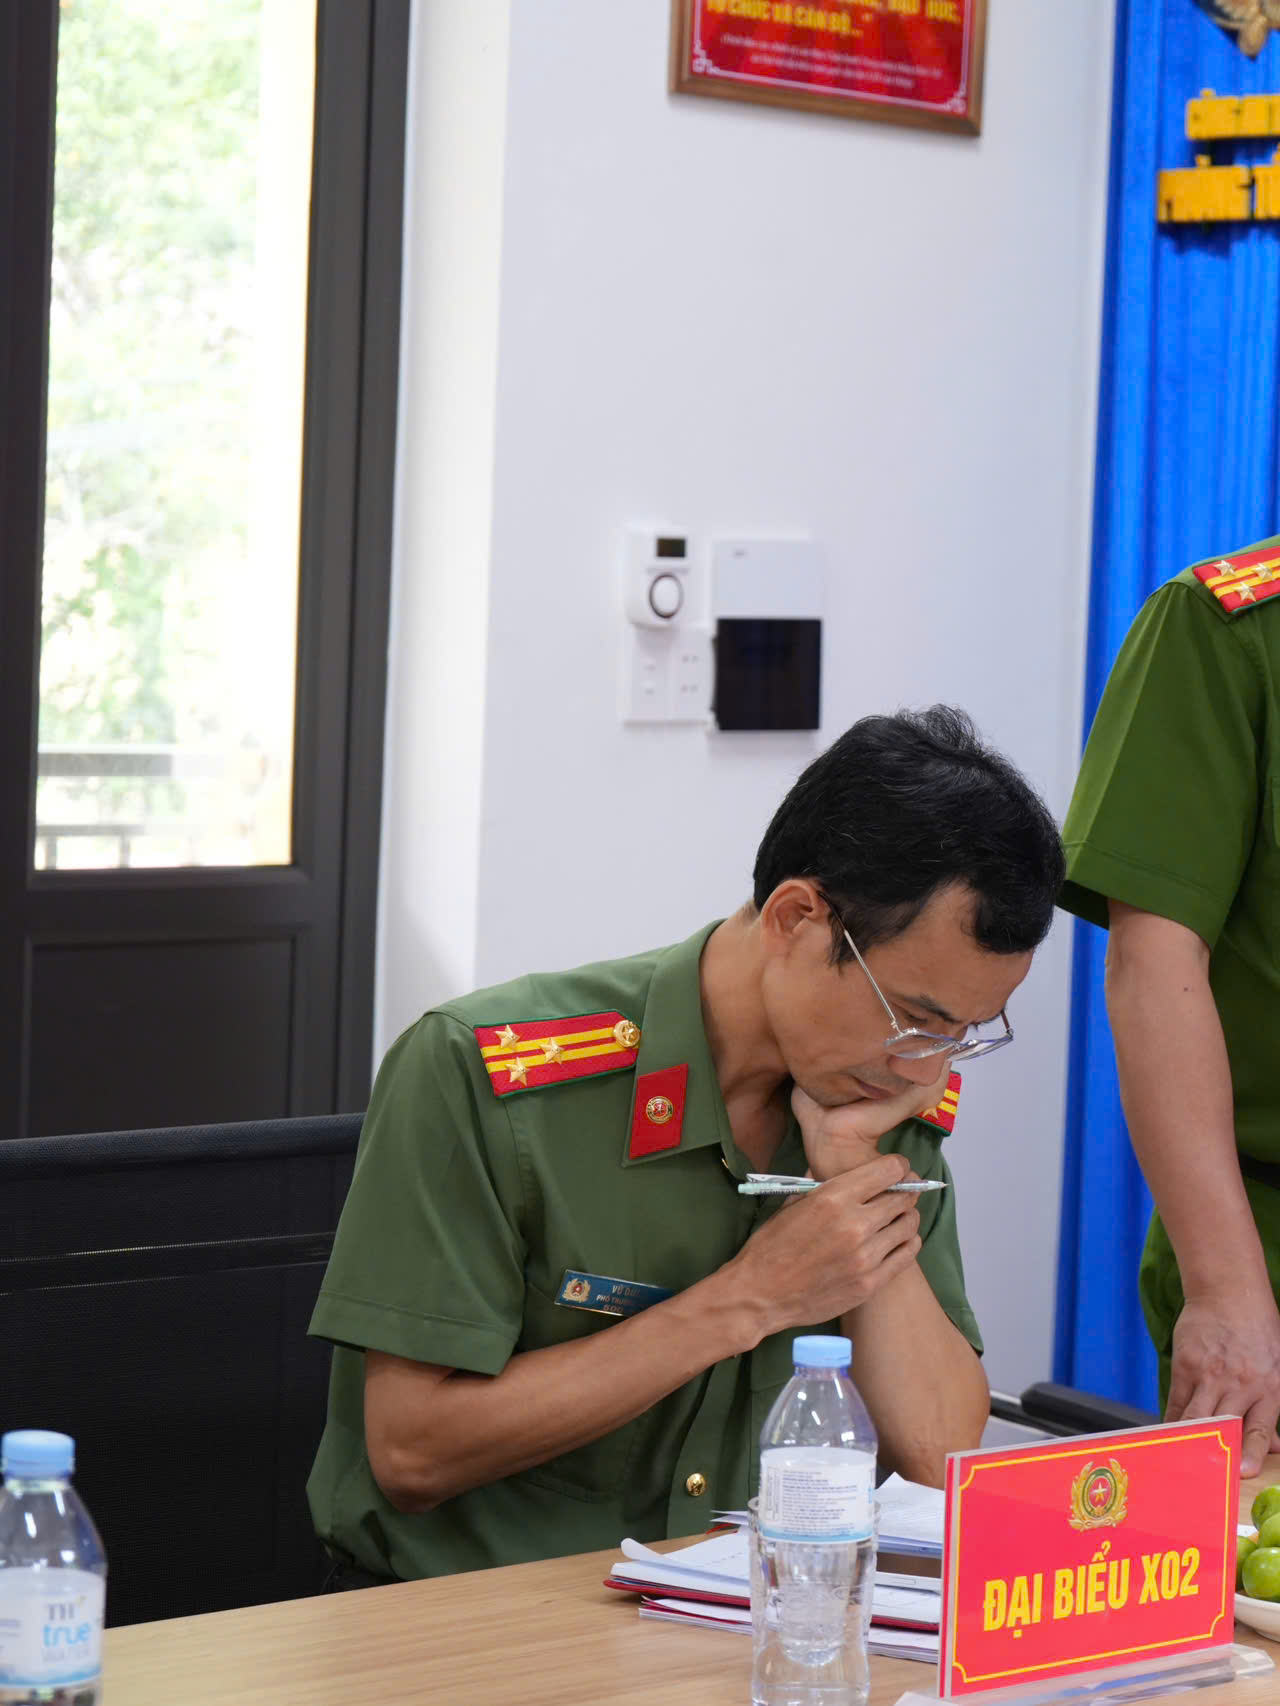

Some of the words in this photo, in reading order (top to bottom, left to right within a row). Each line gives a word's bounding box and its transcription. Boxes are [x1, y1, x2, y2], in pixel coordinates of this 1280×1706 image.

[983, 1572, 1043, 1639] ĐẠI
[1052, 1540, 1131, 1621] BIỂU
[1138, 1546, 1201, 1605] X02
